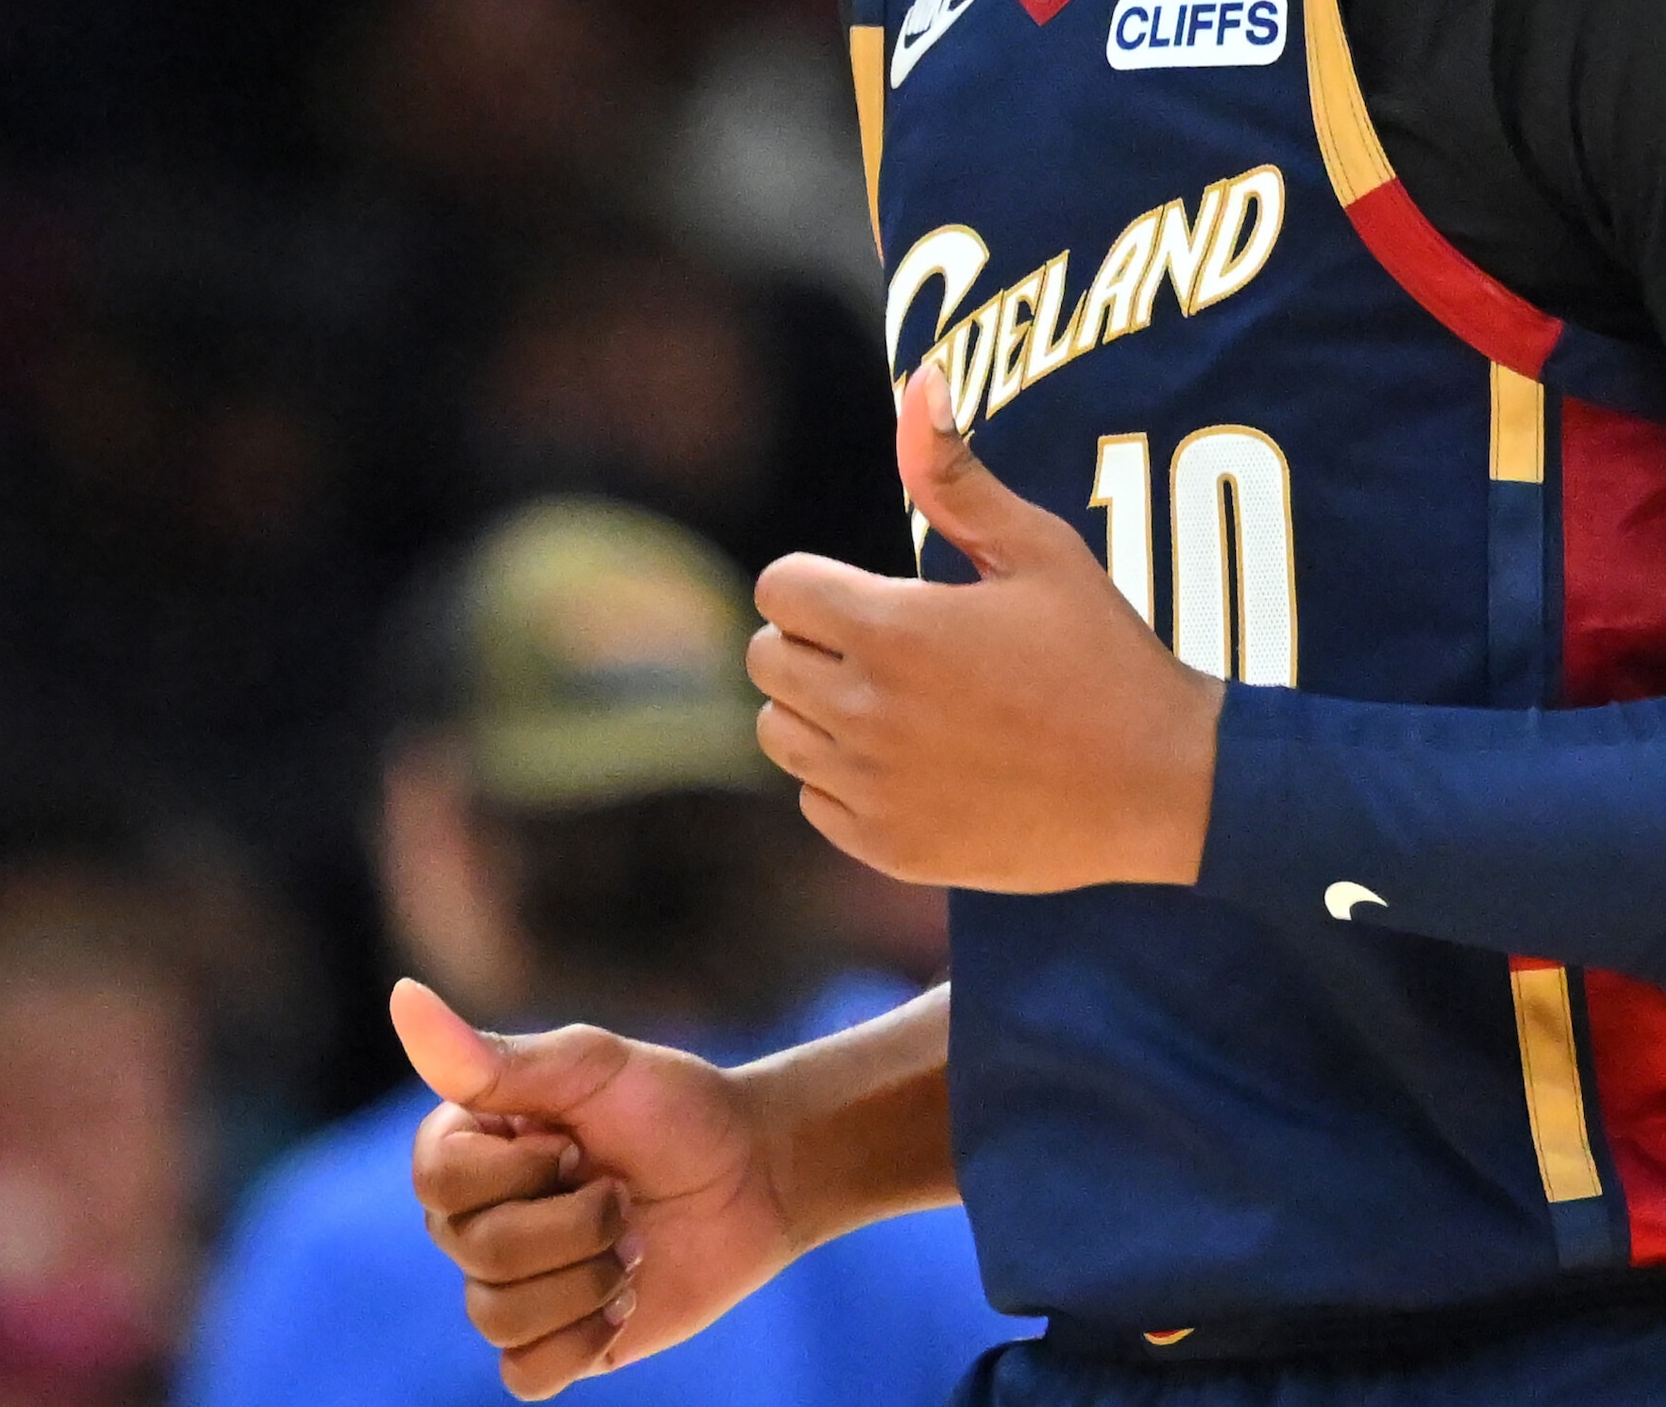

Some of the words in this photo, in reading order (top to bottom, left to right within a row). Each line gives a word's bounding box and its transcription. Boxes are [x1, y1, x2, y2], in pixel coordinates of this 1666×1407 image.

[1115, 0, 1279, 51] CLIFFS
[885, 163, 1286, 436] CVELAND
[1086, 423, 1298, 689] 10
